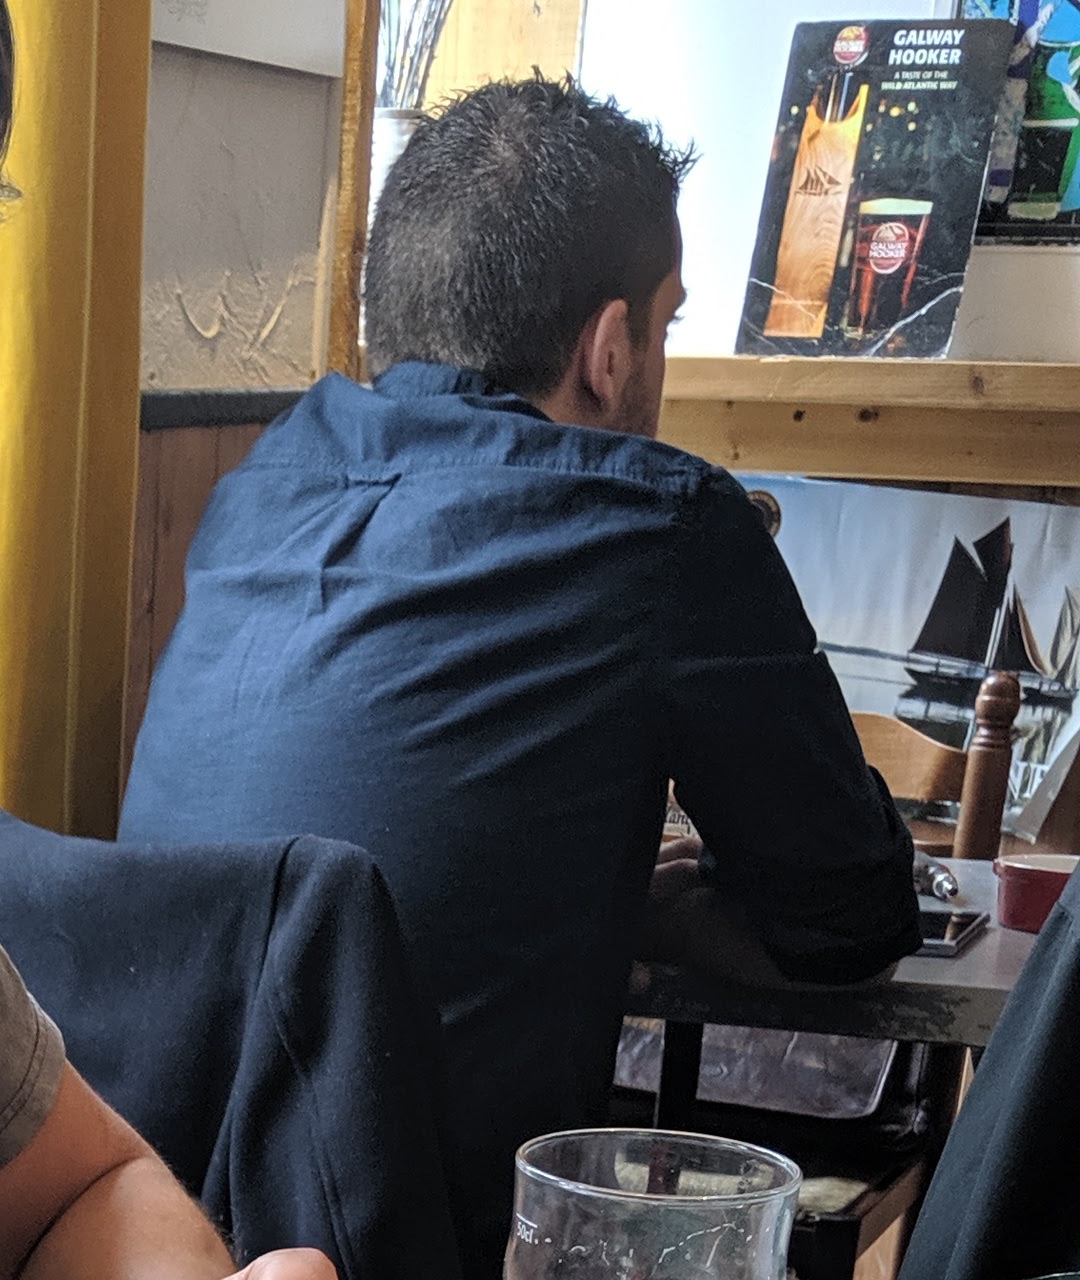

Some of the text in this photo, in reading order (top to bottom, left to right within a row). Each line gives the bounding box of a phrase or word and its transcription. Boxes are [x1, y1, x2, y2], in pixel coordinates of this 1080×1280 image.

[893, 29, 965, 46] GALWAY
[888, 48, 962, 65] HOOKER
[894, 70, 948, 79] A TASTE OF THE
[881, 81, 958, 90] WILD ATLANTIC WAY
